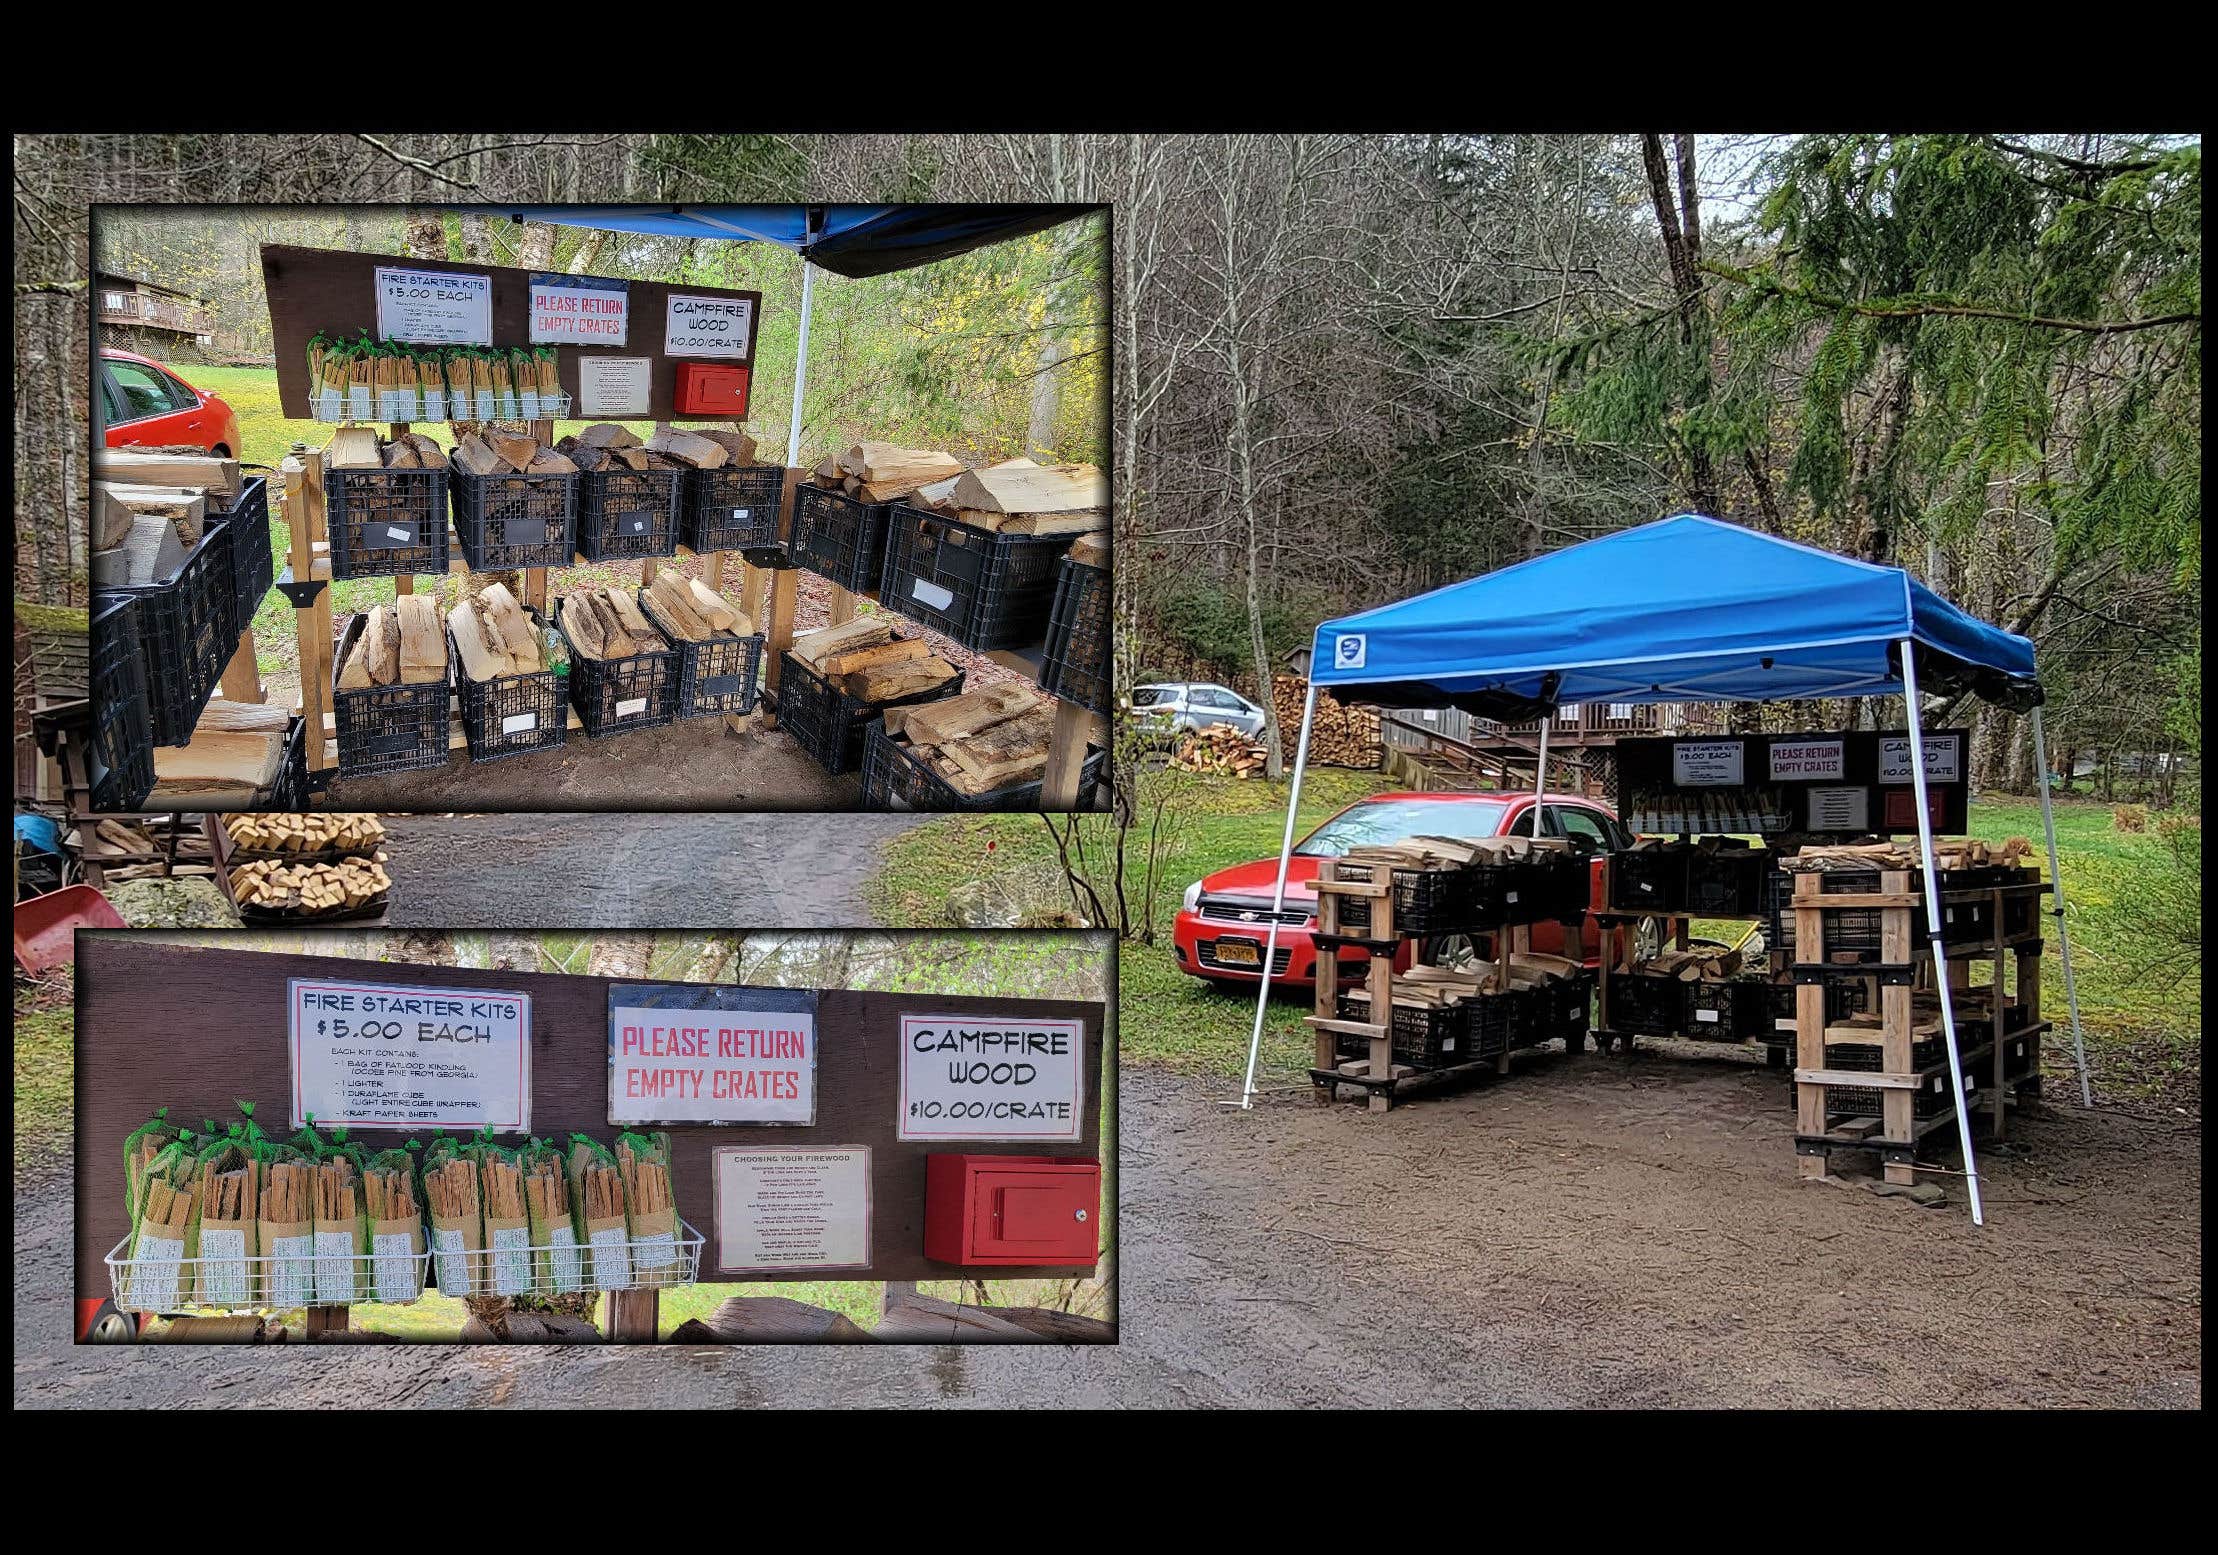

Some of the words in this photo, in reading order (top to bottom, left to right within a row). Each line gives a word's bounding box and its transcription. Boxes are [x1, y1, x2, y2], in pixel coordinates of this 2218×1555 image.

[381, 274, 406, 284] FIRE
[409, 276, 460, 289] STARTER
[462, 281, 485, 290] KITS
[389, 287, 430, 299] $5.00
[437, 290, 473, 302] EACH
[536, 295, 578, 312] PLEASE
[581, 298, 623, 314] RETURN
[673, 302, 744, 317] CAMPFIRE
[538, 316, 575, 333] EMPTY
[578, 319, 620, 335] CRATES
[688, 319, 729, 331] WOOD
[670, 336, 743, 348] $10.00/CRATE
[1772, 749, 1803, 760] PLEASE
[1805, 747, 1840, 758] RETURN
[1884, 740, 1953, 752] CAMFIRE
[1774, 762, 1801, 773] EMPTY
[1804, 761, 1838, 772] CRATES
[304, 993, 354, 1012] FIRE
[361, 996, 464, 1017] STARTER
[471, 1002, 517, 1019] KITS
[317, 1018, 402, 1040] $5.00
[417, 1021, 491, 1043] EACH
[622, 1026, 710, 1057] PLEASE
[718, 1028, 805, 1059] RETURN
[913, 1029, 1069, 1056] CAMPFIRE
[375, 1050, 419, 1058] CONTANS:
[347, 1060, 368, 1068] BAG
[428, 1063, 467, 1071] KINDLING
[387, 1069, 407, 1077] PINE
[410, 1070, 434, 1078] FROM
[948, 1061, 1037, 1086] WOOD
[626, 1068, 704, 1099] EMPTY
[712, 1070, 798, 1100] CRATES
[347, 1091, 399, 1099] DURAFLAME
[909, 1100, 1071, 1120] $10.00/CRATE
[734, 1155, 779, 1163] CHOOSING
[806, 1154, 850, 1162] FIREWOOD
